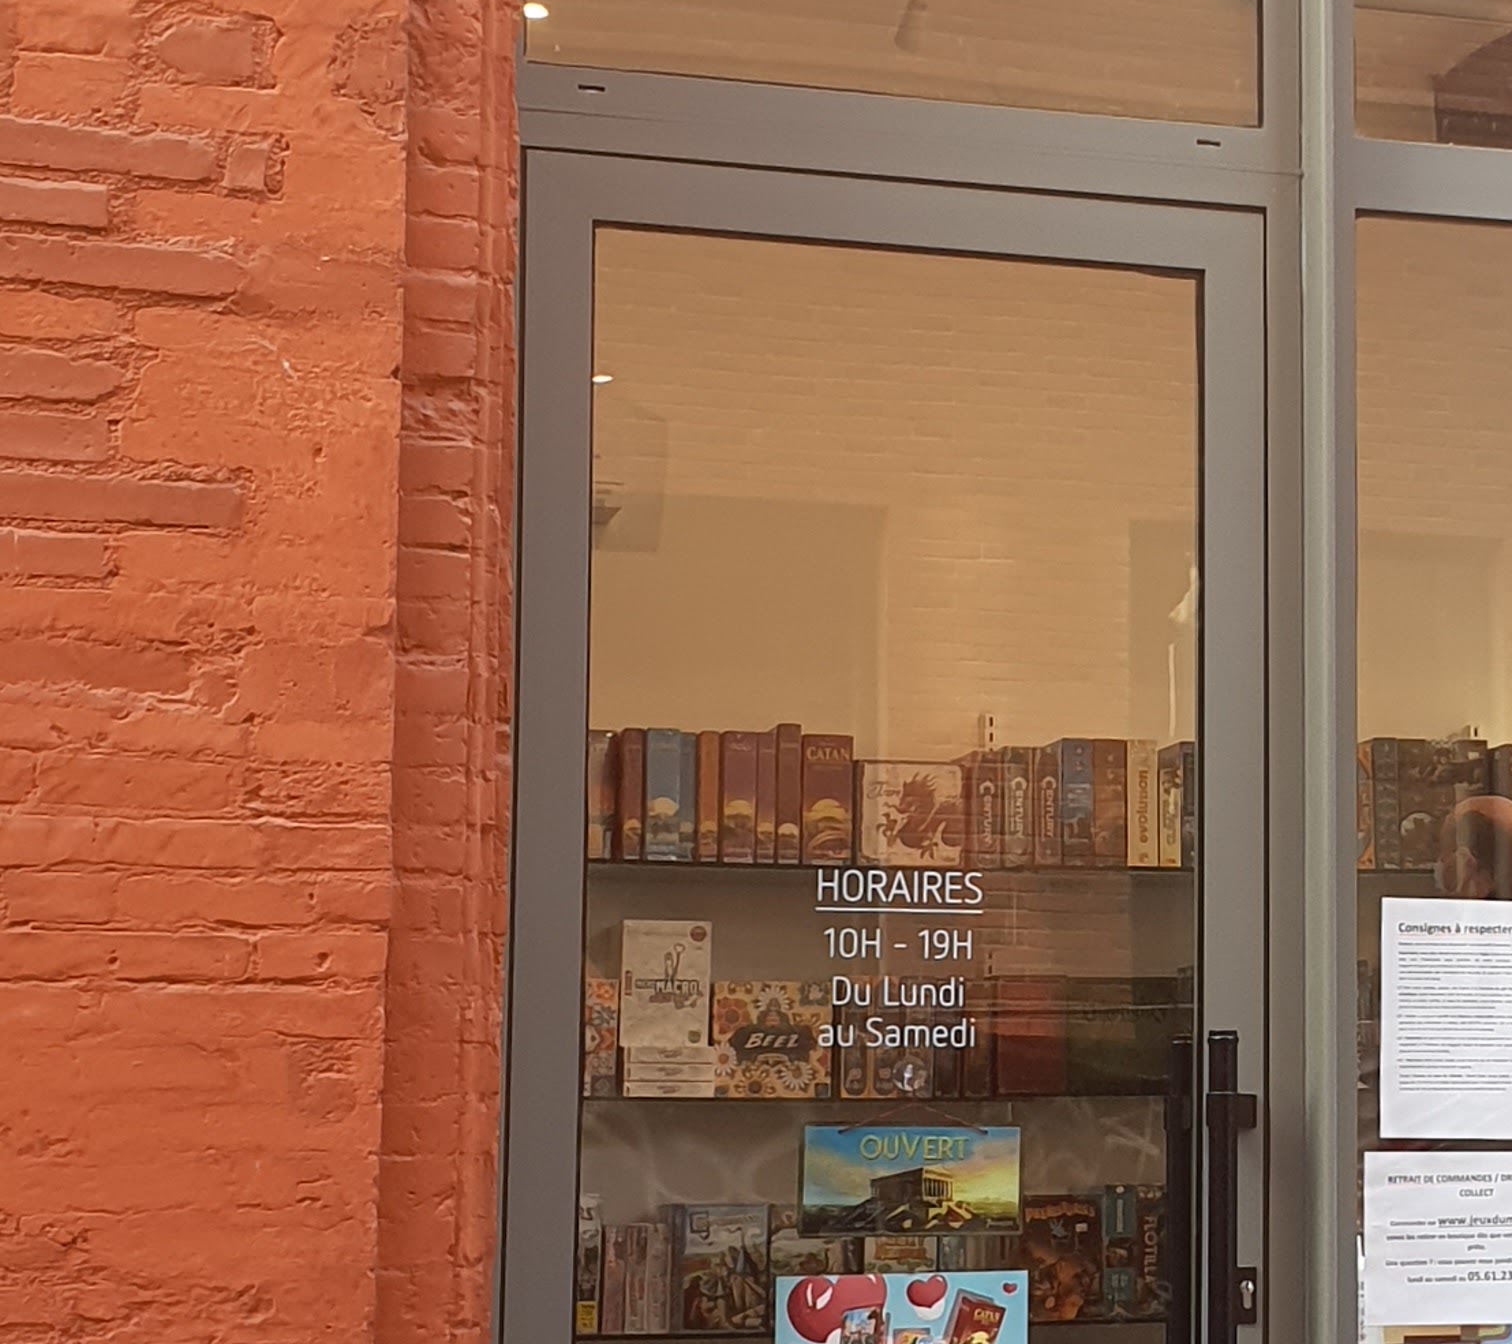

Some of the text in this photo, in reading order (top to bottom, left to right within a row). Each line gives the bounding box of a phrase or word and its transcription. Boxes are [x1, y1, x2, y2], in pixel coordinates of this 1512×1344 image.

[806, 746, 850, 761] CATAN
[817, 868, 983, 904] HORAIRES
[1398, 922, 1452, 935] Consignes
[1464, 924, 1512, 935] respecter
[823, 927, 881, 958] 10H
[918, 929, 973, 960] 19H
[655, 979, 699, 995] MACRO
[832, 975, 964, 1007] Du Lundi
[745, 1032, 799, 1048] BEEZ
[817, 1016, 976, 1048] au Samedi
[860, 1134, 969, 1161] OUVERT
[1387, 1174, 1422, 1184] RETRAIT
[1424, 1174, 1434, 1184] DE
[1436, 1174, 1492, 1183] COMMANDES
[1459, 1188, 1494, 1198] COLLECT
